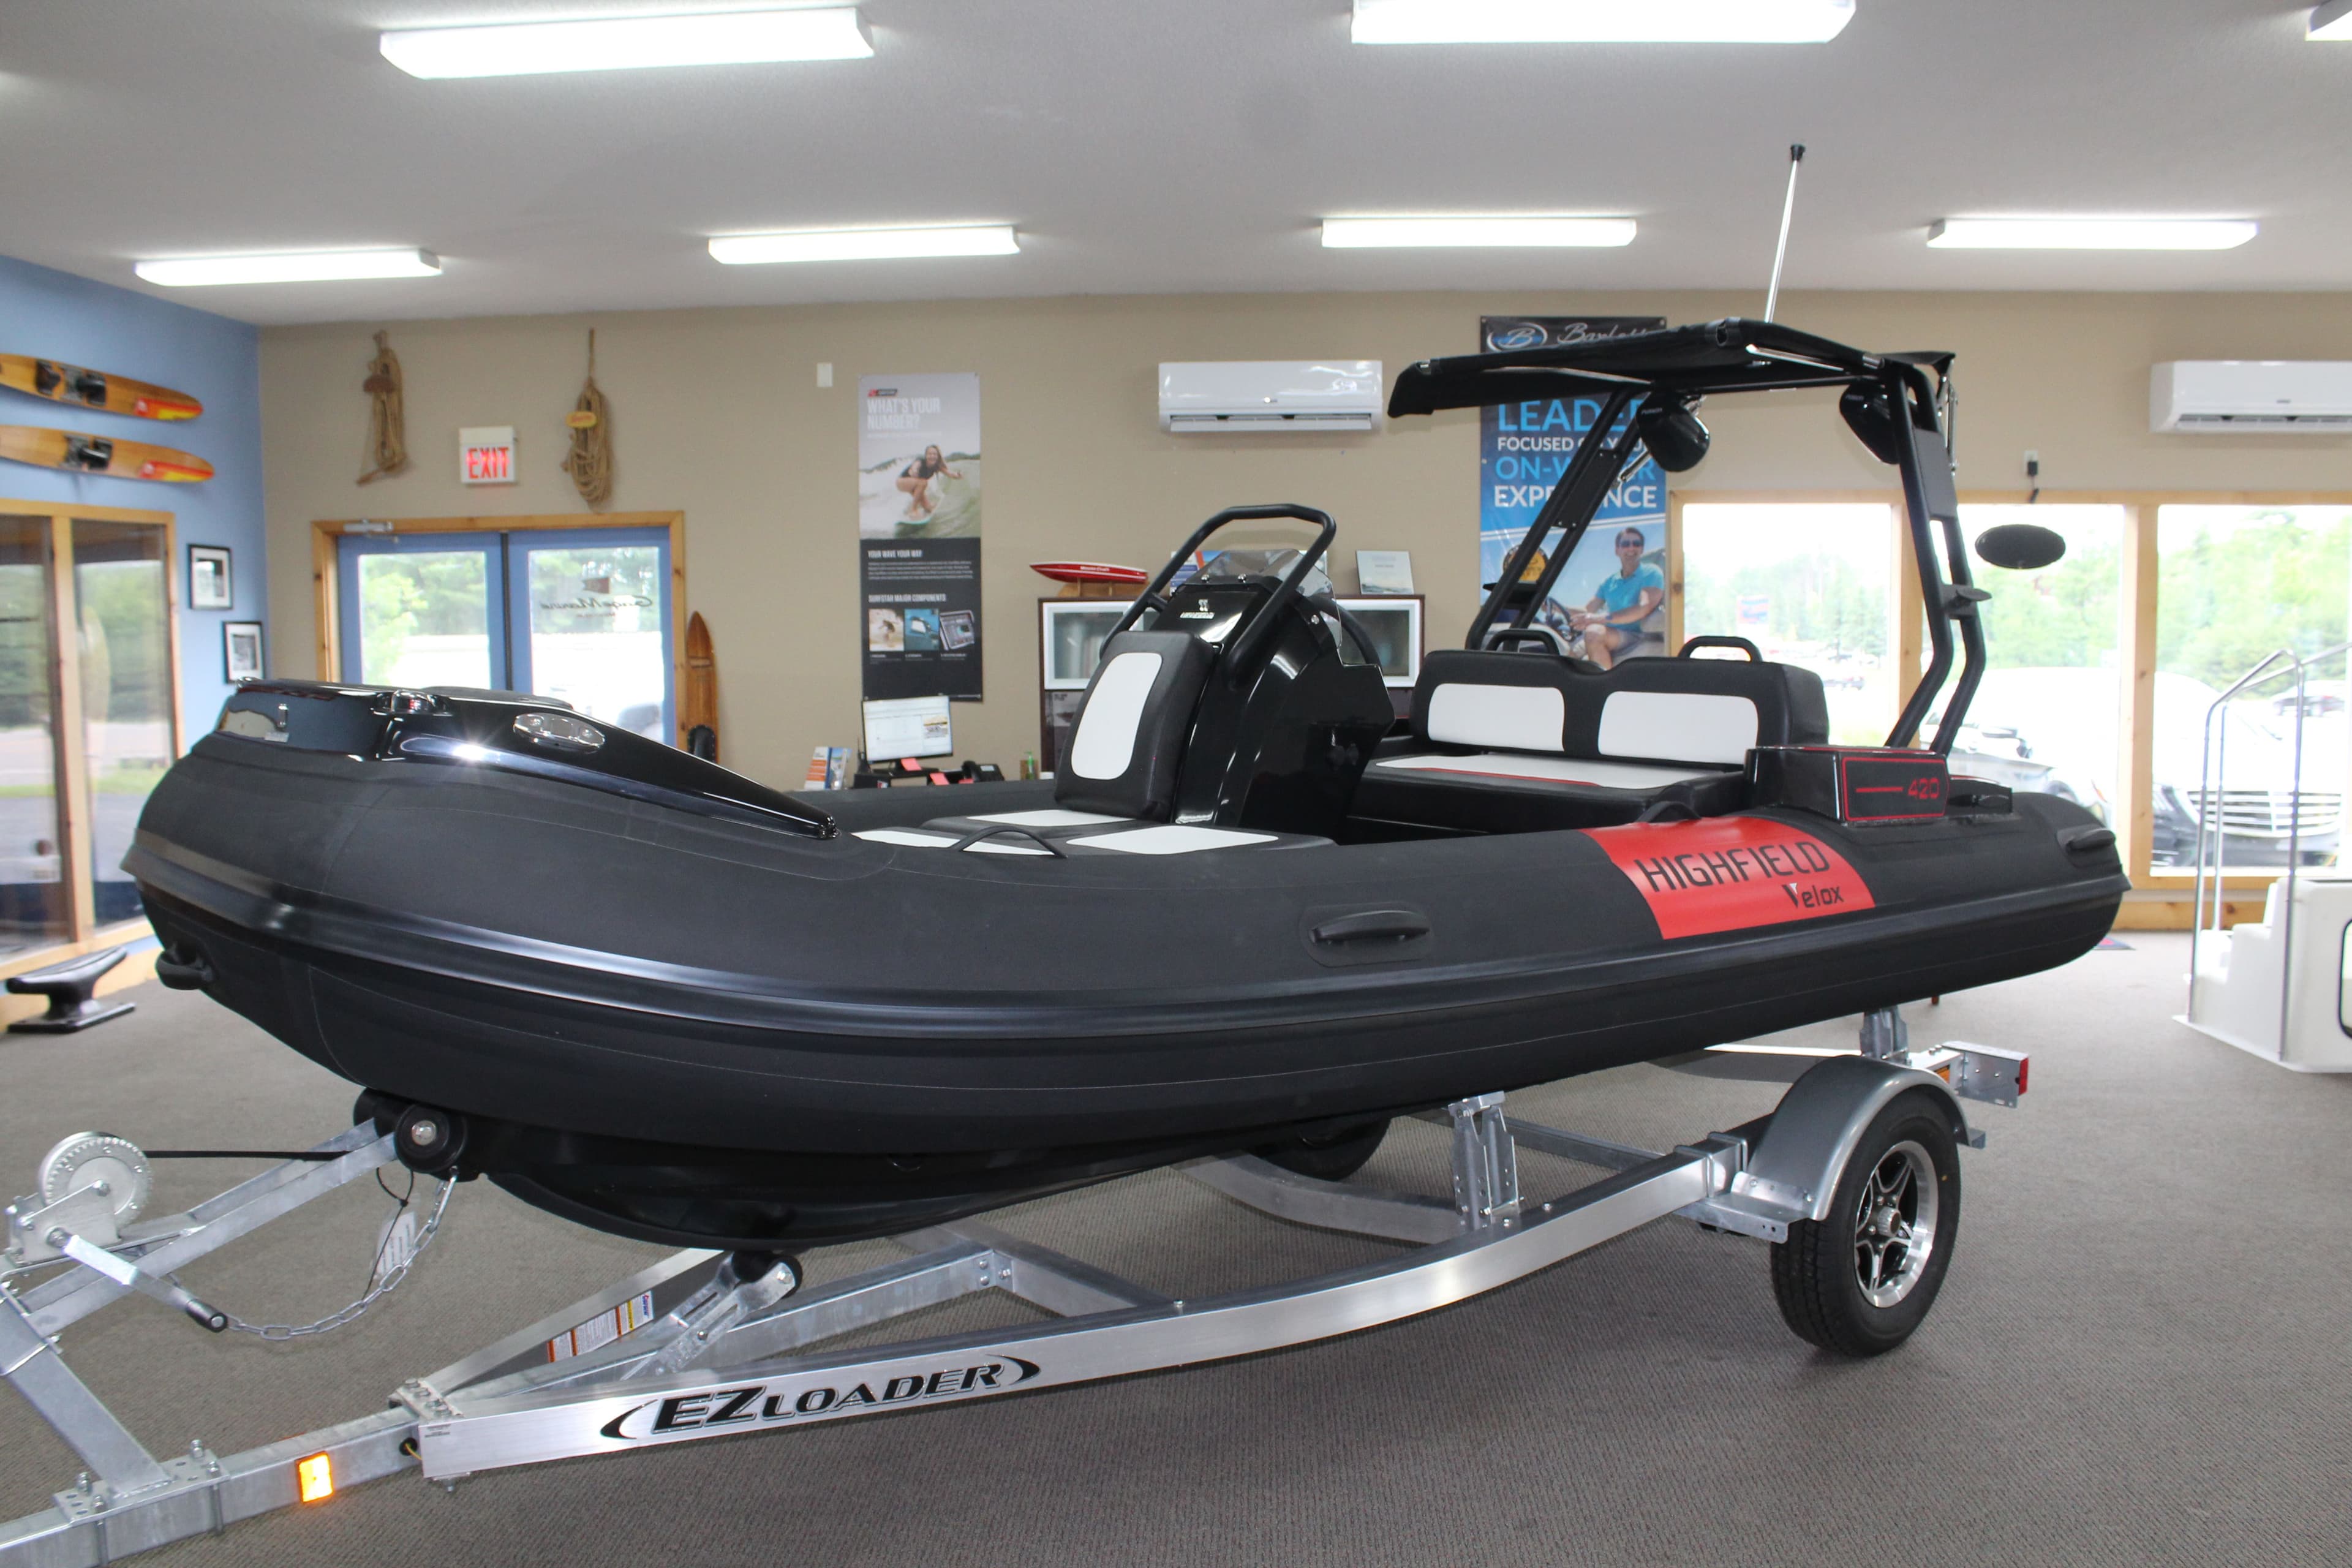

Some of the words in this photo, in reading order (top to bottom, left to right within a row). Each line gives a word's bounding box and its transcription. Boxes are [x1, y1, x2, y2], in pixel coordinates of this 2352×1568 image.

[867, 398, 908, 413] WHAT'S
[911, 397, 940, 413] YOUR
[867, 415, 920, 429] NUMBER?
[1498, 437, 1574, 451] FOCUSED
[467, 447, 509, 478] EXIT
[1908, 777, 1940, 800] 420
[1634, 842, 1830, 892] HIGHFIELD
[1782, 882, 1845, 908] Velox
